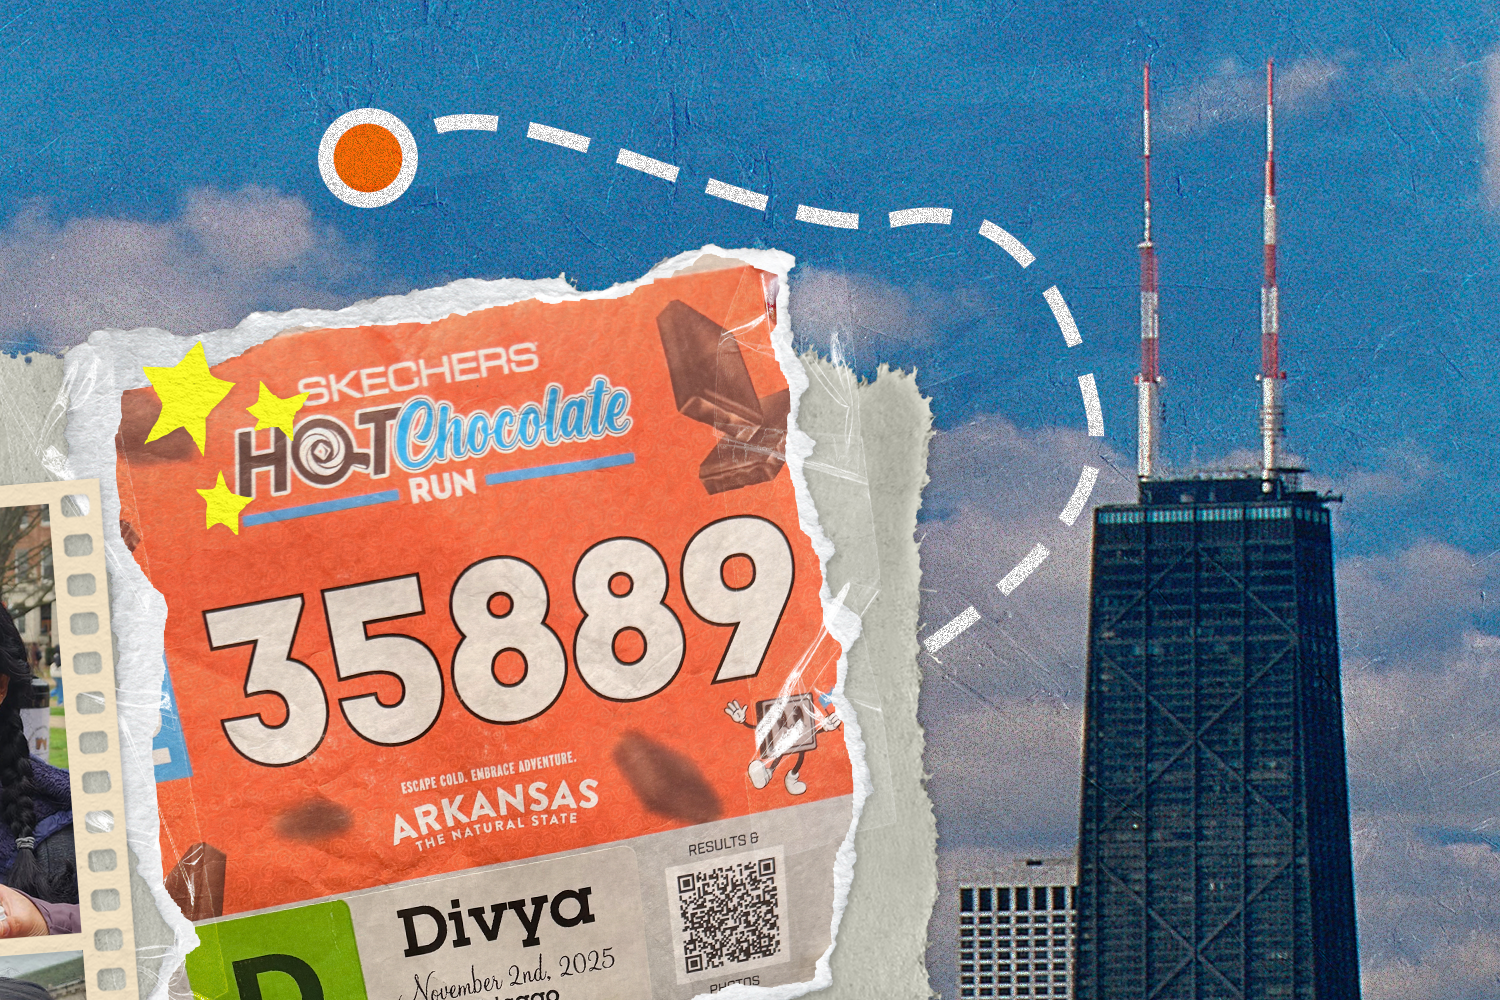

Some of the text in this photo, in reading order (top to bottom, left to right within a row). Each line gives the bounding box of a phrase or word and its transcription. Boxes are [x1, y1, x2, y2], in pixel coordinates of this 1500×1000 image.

[298, 343, 539, 406] SKECHERS
[235, 374, 631, 500] HOT Chocolate
[409, 468, 477, 504] RUN
[202, 514, 796, 768] 35889
[400, 751, 577, 795] ESCAPE COLD. EMBRACE ADVENTURE.
[393, 778, 599, 846] ARKANSAS
[415, 812, 578, 852] THE NATURAL STATE
[688, 832, 759, 856] RESULTS &
[397, 886, 596, 958] Divya
[508, 953, 552, 986] 2nd,
[558, 946, 615, 978] 2025
